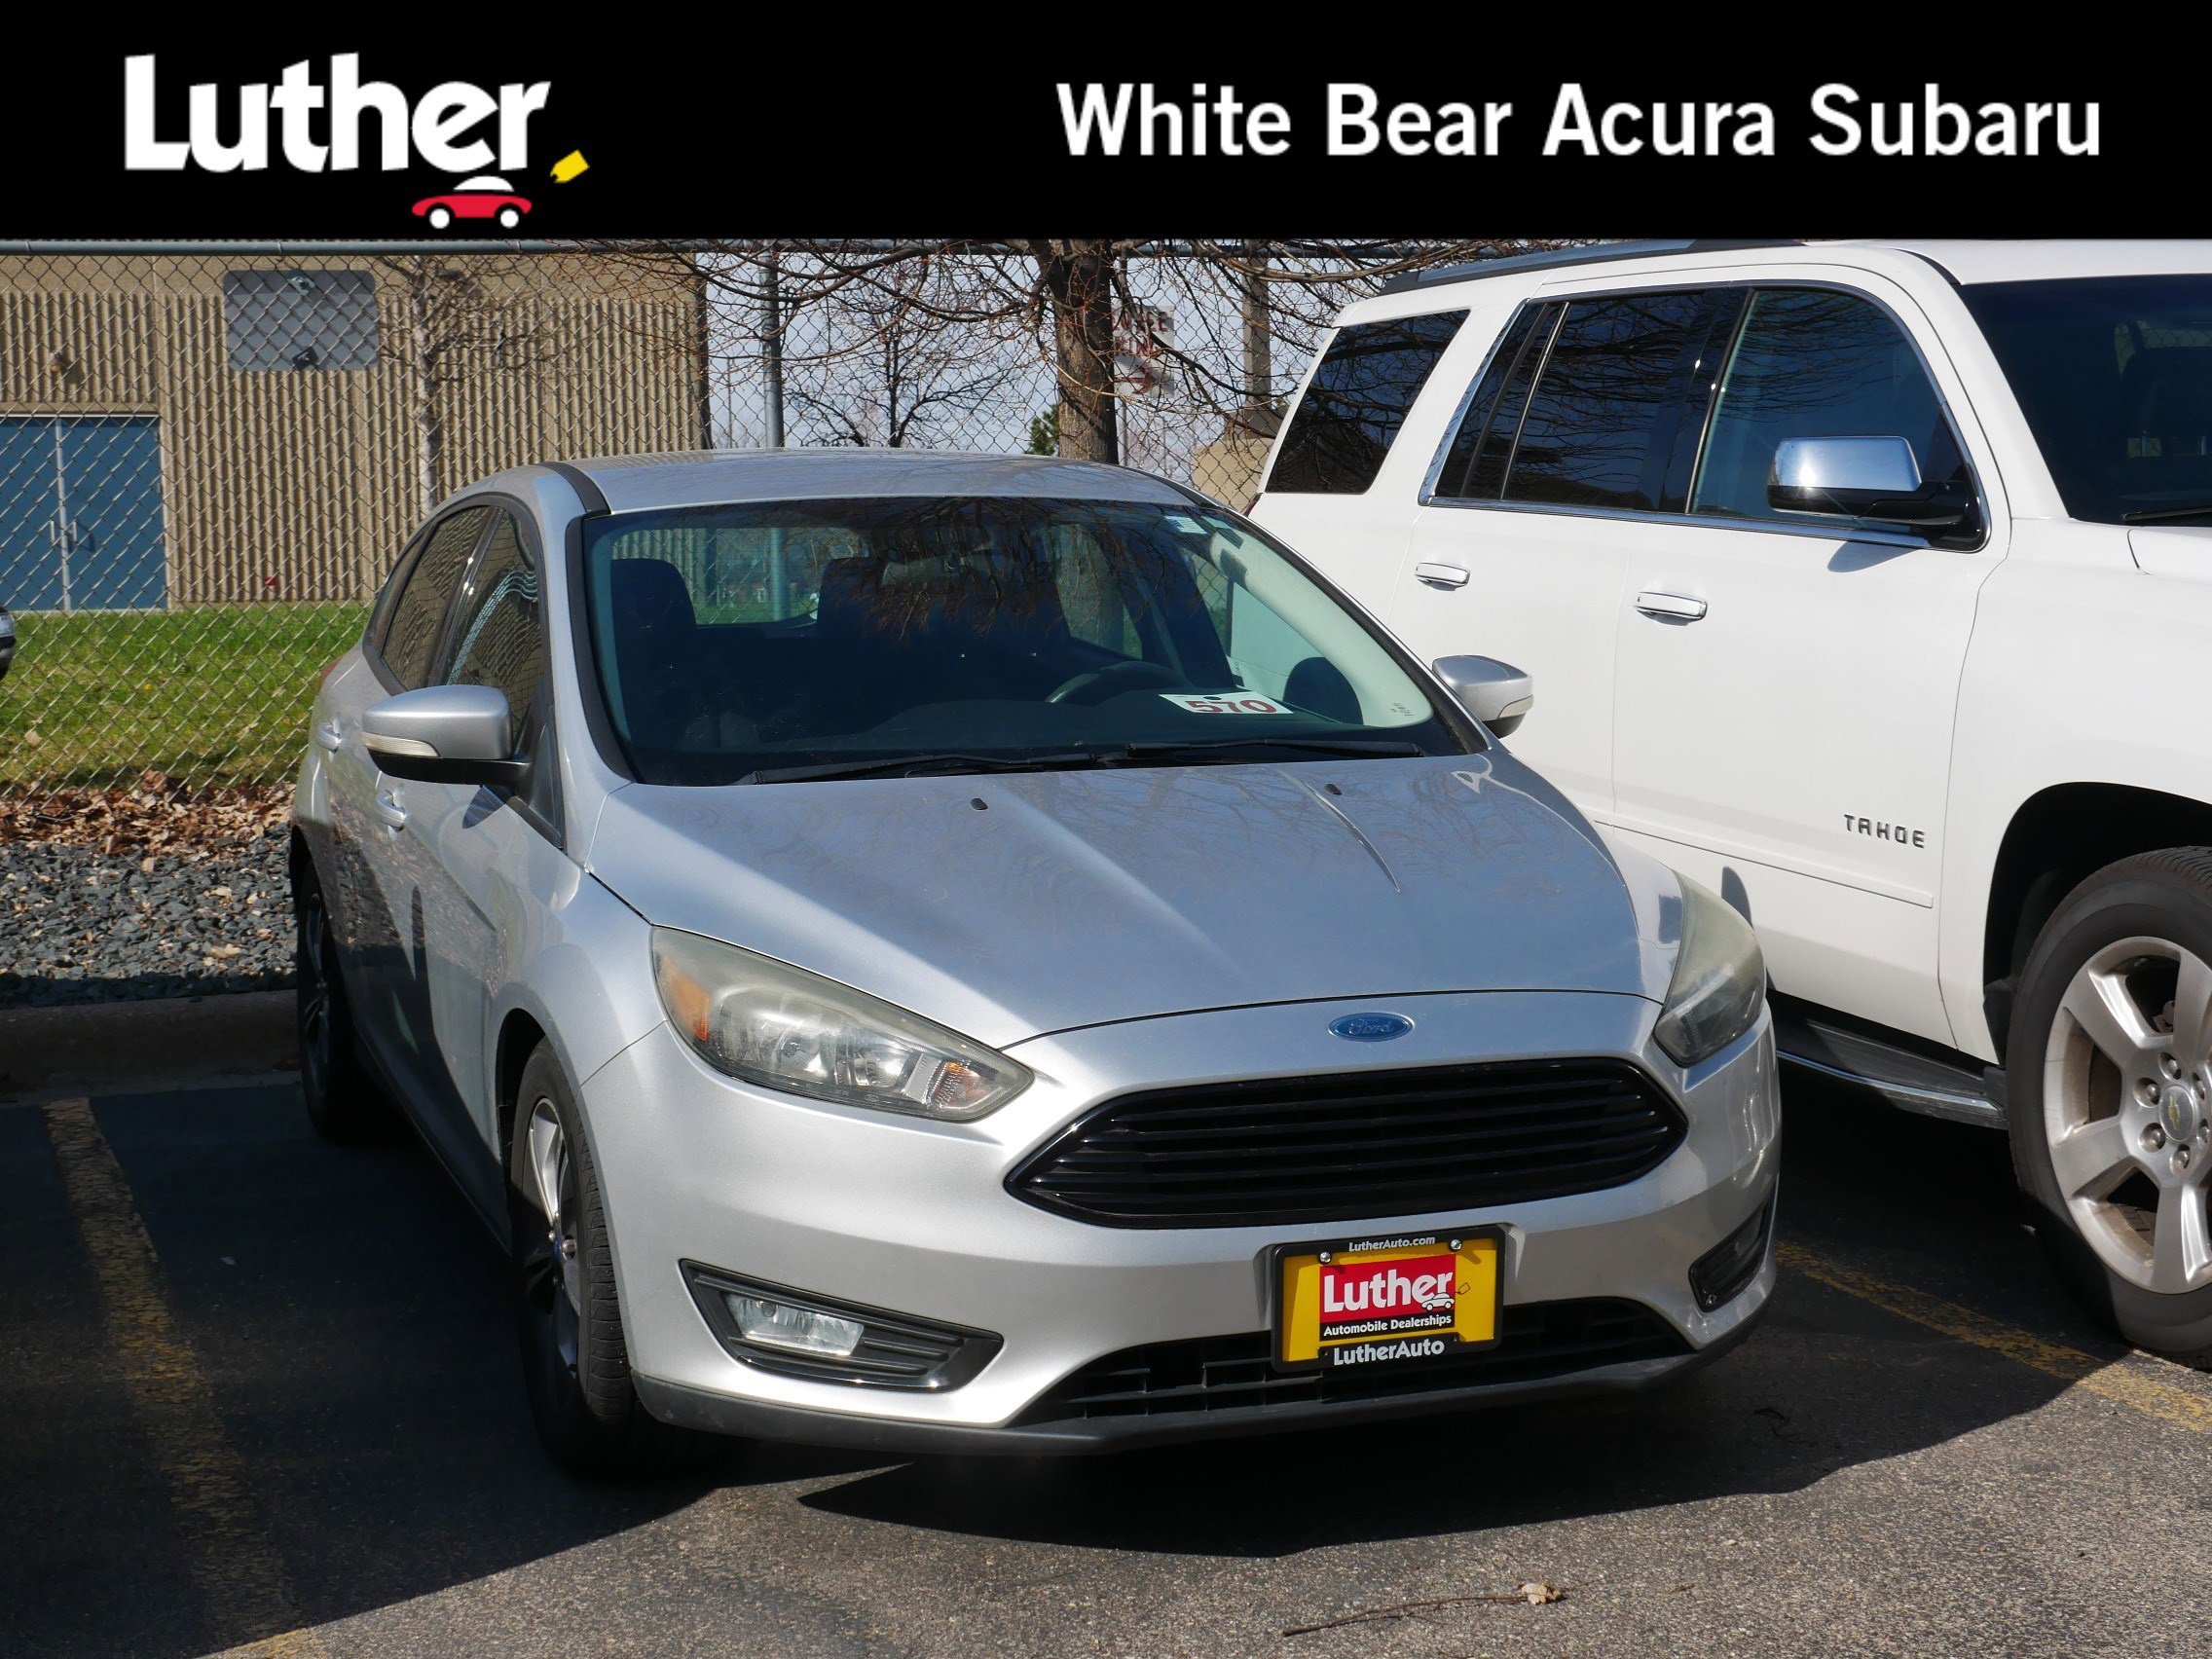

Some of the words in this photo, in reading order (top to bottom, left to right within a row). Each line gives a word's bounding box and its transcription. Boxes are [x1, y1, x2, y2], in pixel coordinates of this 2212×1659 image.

[1185, 699, 1277, 714] 570
[1844, 814, 1925, 849] TAHOE
[1348, 1236, 1435, 1252] LutherAuto.com
[1324, 1269, 1454, 1313] Luther
[1323, 1320, 1388, 1337] Automobile
[1390, 1314, 1452, 1330] Dealerships
[1334, 1339, 1445, 1365] LutherAuto
